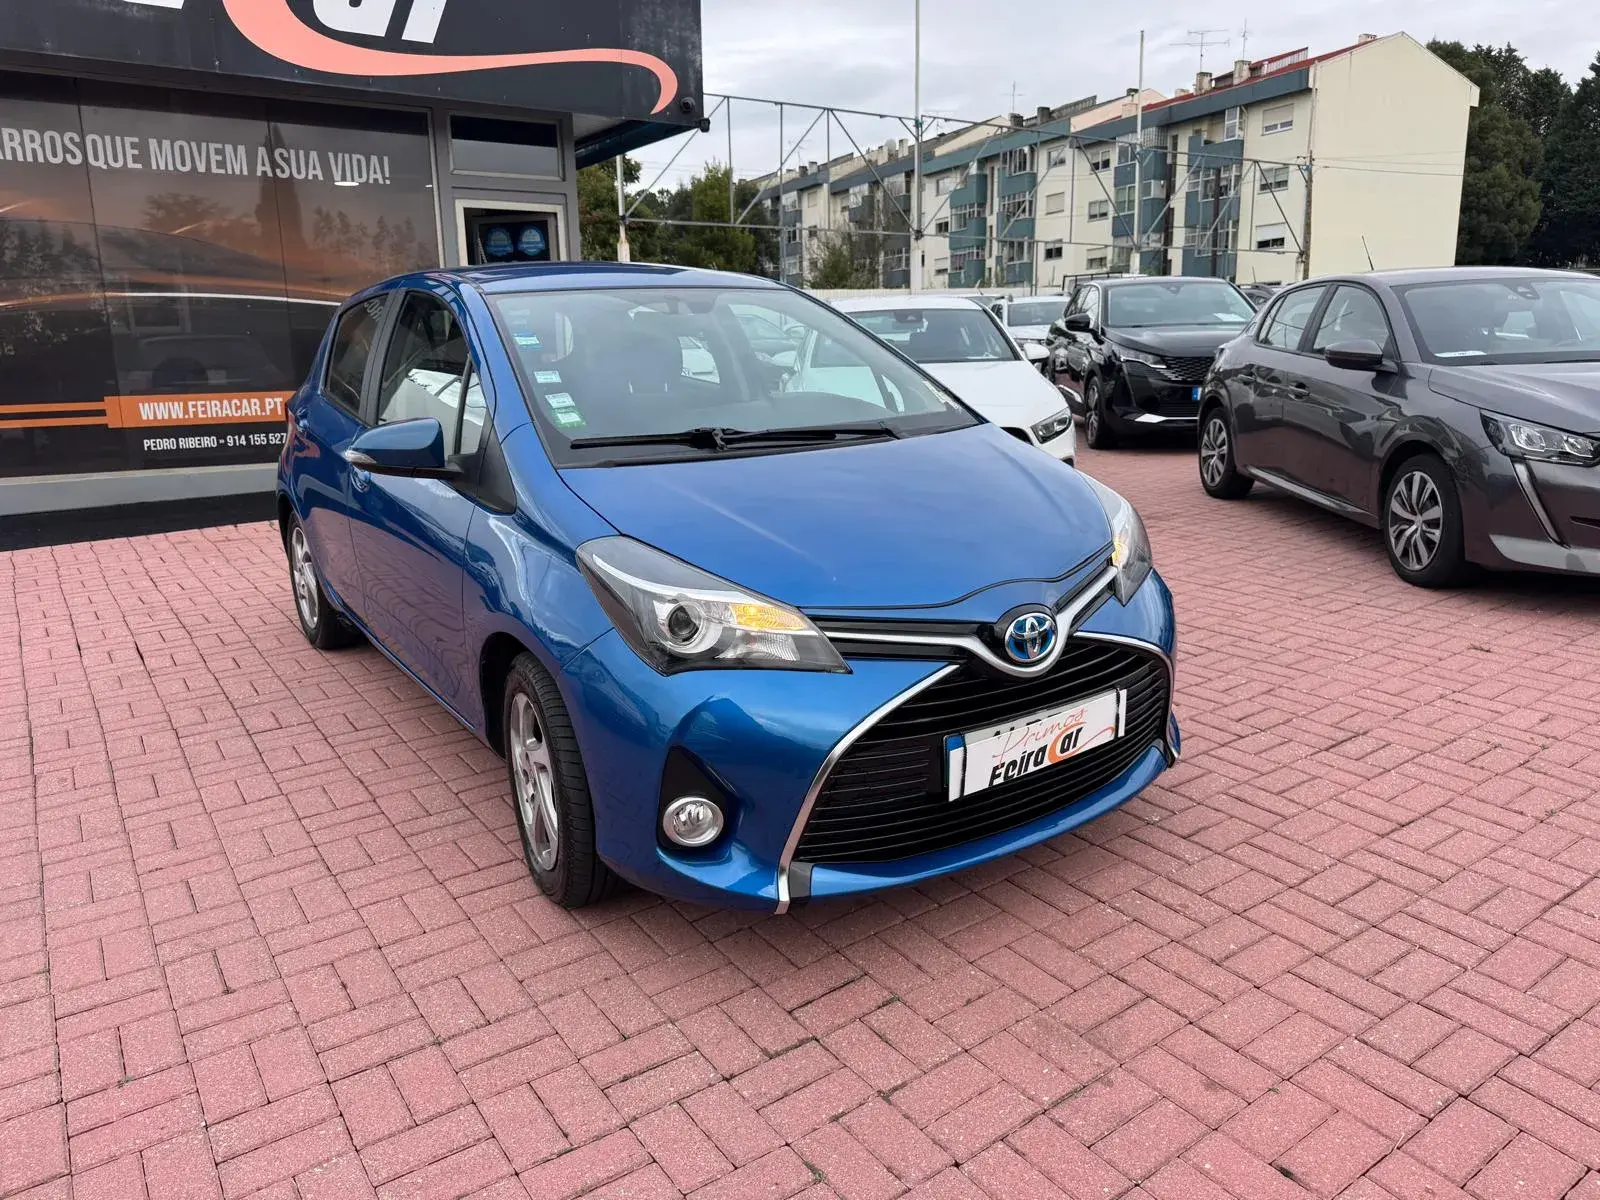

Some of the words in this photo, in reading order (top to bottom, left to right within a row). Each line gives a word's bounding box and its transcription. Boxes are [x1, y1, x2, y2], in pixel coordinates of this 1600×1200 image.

[0, 127, 82, 165] RROS
[86, 133, 142, 169] QUE
[148, 138, 248, 175] MOVEM
[256, 146, 273, 177] A
[274, 148, 324, 181] SUA
[328, 151, 391, 184] VIDA!
[138, 398, 283, 420] WWW.FEIRACAR.PT
[143, 438, 177, 451] PEDRO
[179, 436, 217, 449] RIBEIRO
[226, 434, 247, 447] 914
[249, 433, 267, 446] 155
[269, 432, 287, 444] 527
